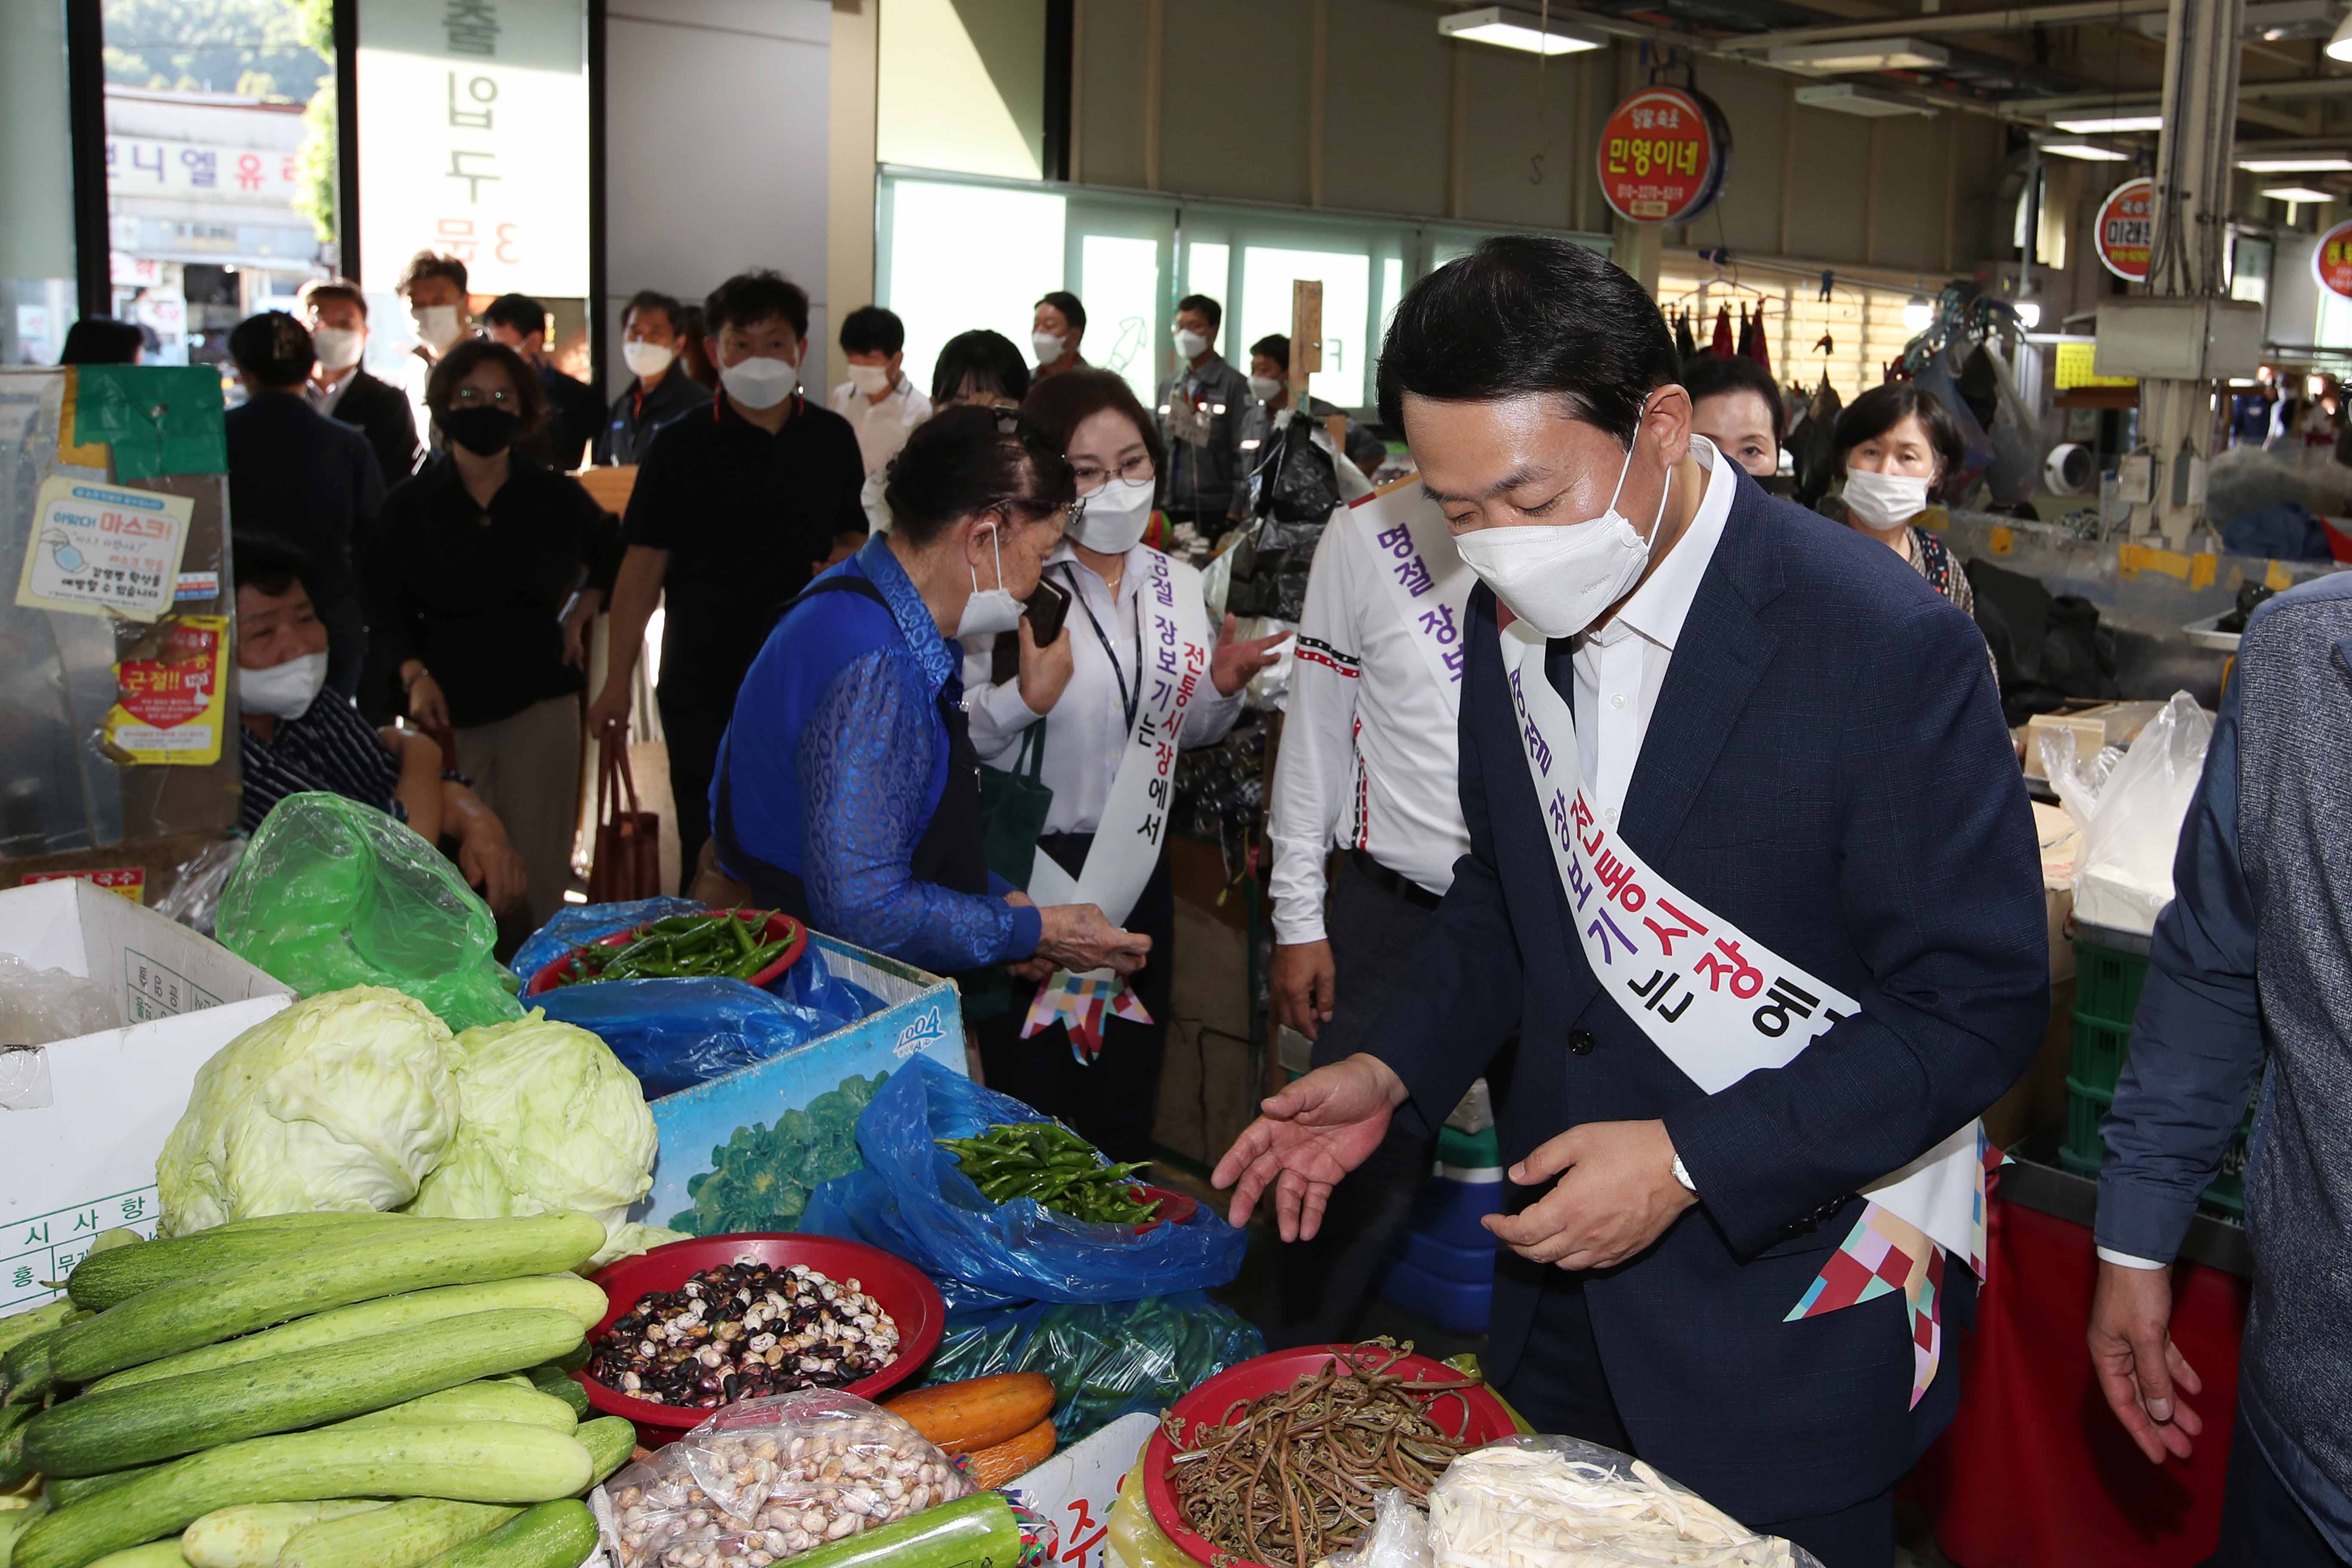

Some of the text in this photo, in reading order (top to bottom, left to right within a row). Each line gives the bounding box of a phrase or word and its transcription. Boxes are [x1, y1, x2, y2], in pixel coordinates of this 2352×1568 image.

[1609, 138, 1699, 177] 민영이네
[1377, 523, 1435, 597] 명절
[1137, 642, 1204, 845] 전통시장에서
[1139, 615, 1178, 747] 장보기는
[1548, 787, 1696, 1023] 장보기는
